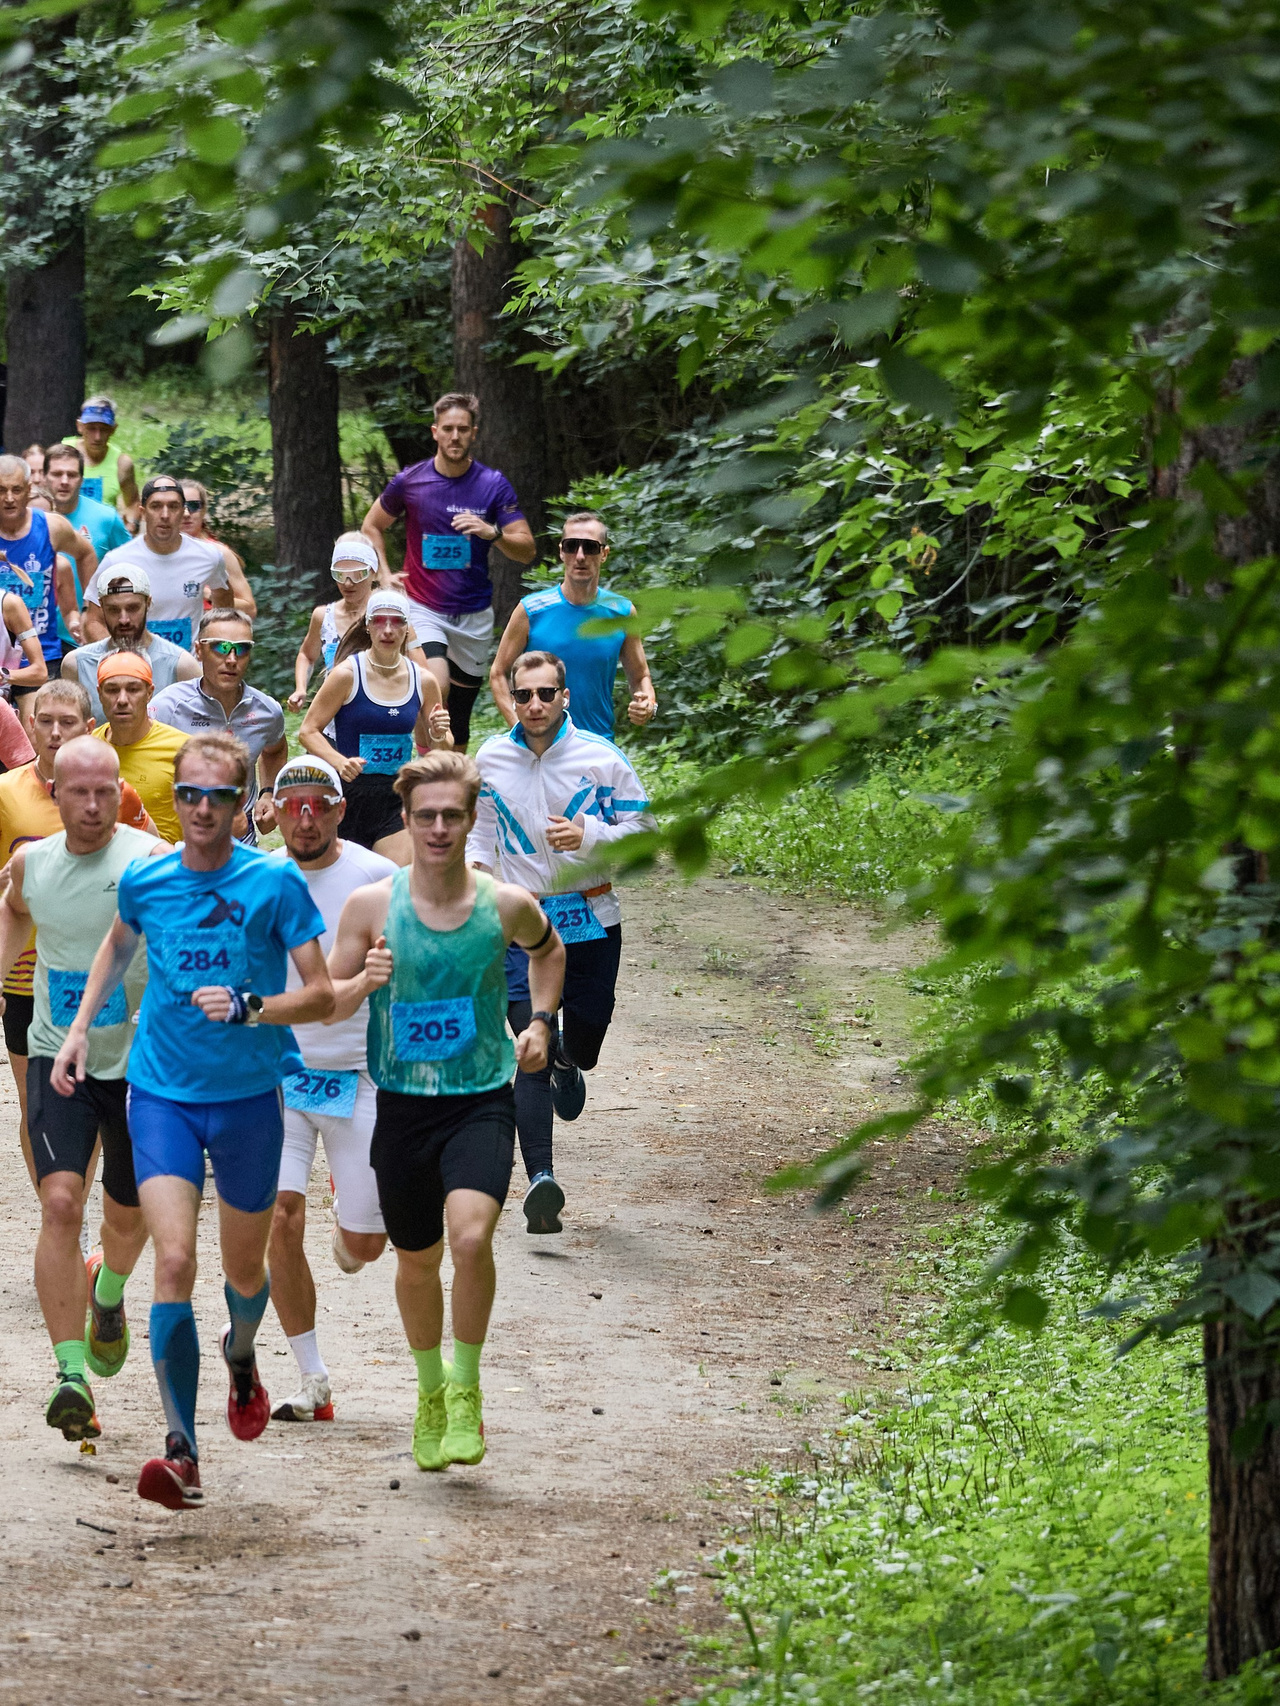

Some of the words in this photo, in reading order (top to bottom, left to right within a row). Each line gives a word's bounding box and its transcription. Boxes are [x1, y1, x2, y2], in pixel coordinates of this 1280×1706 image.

[431, 546, 462, 559] 225
[8, 584, 35, 598] 314
[35, 564, 54, 635] RUSSIA
[370, 747, 404, 764] 334
[556, 907, 592, 929] 231
[178, 948, 231, 971] 284
[407, 1018, 462, 1043] 205
[293, 1073, 341, 1099] 276
